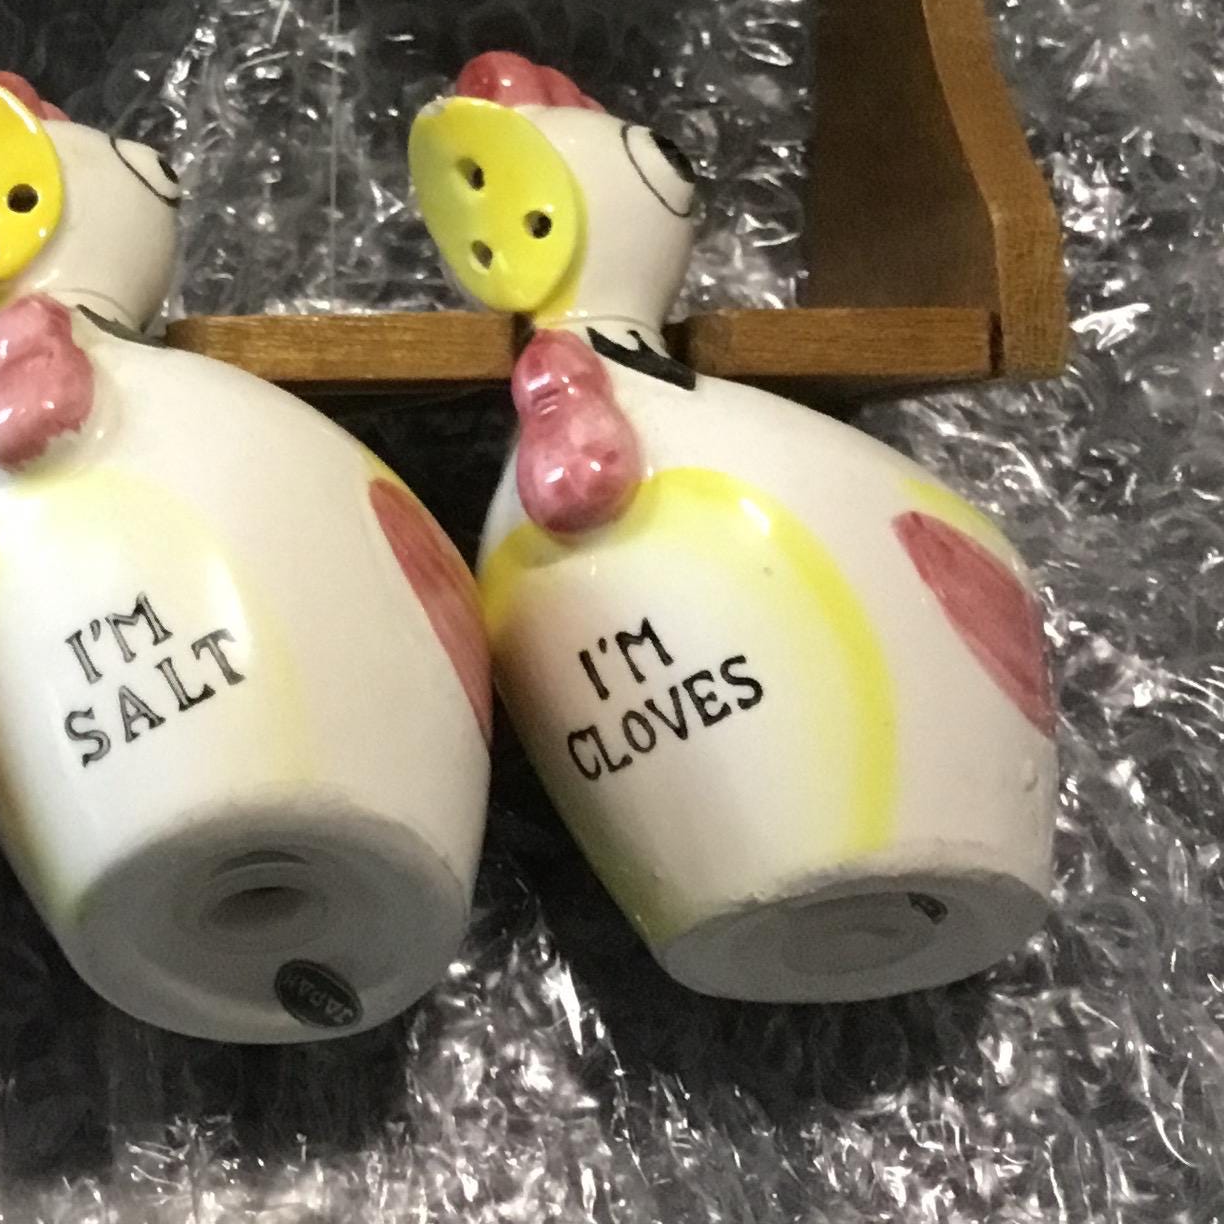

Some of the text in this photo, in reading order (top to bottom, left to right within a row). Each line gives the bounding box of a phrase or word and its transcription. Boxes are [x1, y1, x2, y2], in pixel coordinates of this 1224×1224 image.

[64, 591, 174, 685] I'M
[578, 616, 674, 701] I'M
[63, 627, 246, 768] SALT
[567, 654, 764, 781] CLOVES
